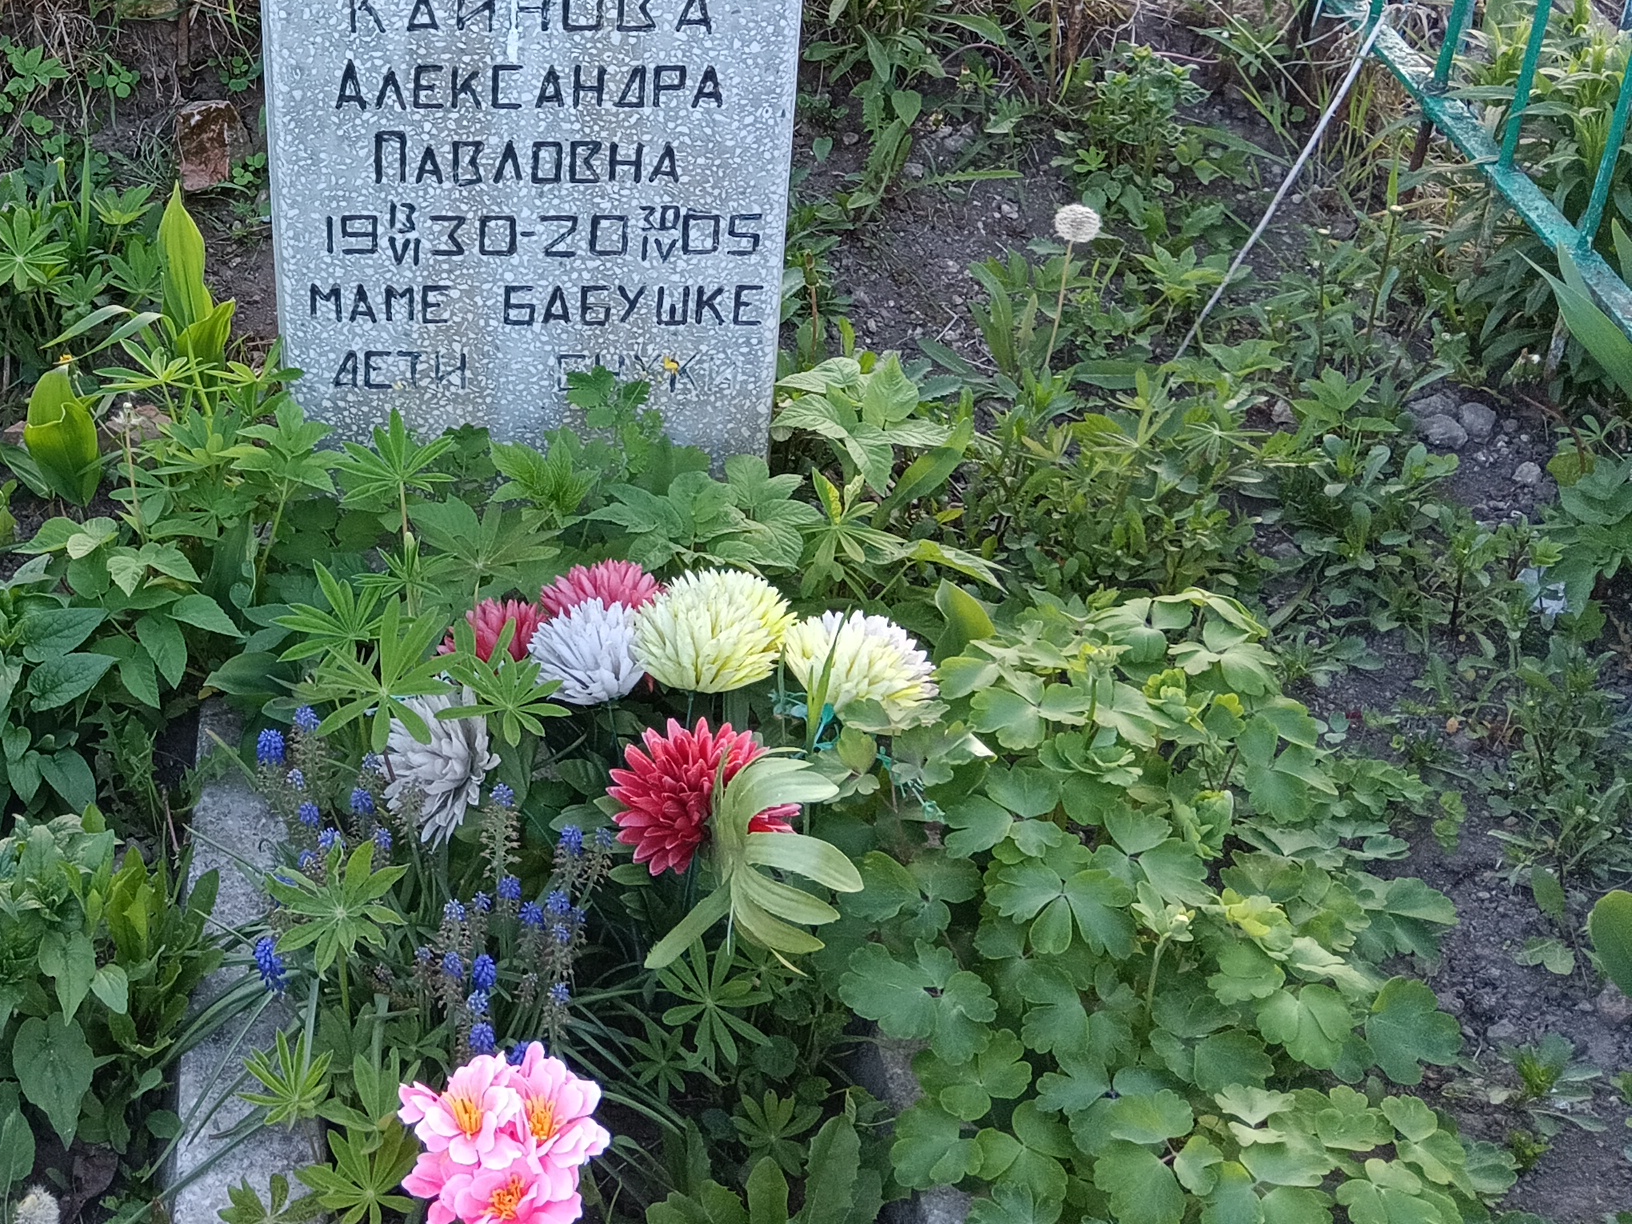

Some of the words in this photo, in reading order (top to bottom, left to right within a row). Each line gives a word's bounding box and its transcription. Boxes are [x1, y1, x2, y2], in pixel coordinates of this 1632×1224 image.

[335, 58, 724, 111] АЛЕКСАНДРА
[373, 130, 681, 187] ПАВЛОВНА
[309, 284, 451, 325] МАМЕ
[502, 284, 765, 327] БАБУШКЕ
[332, 349, 469, 391] ДЕТИ
